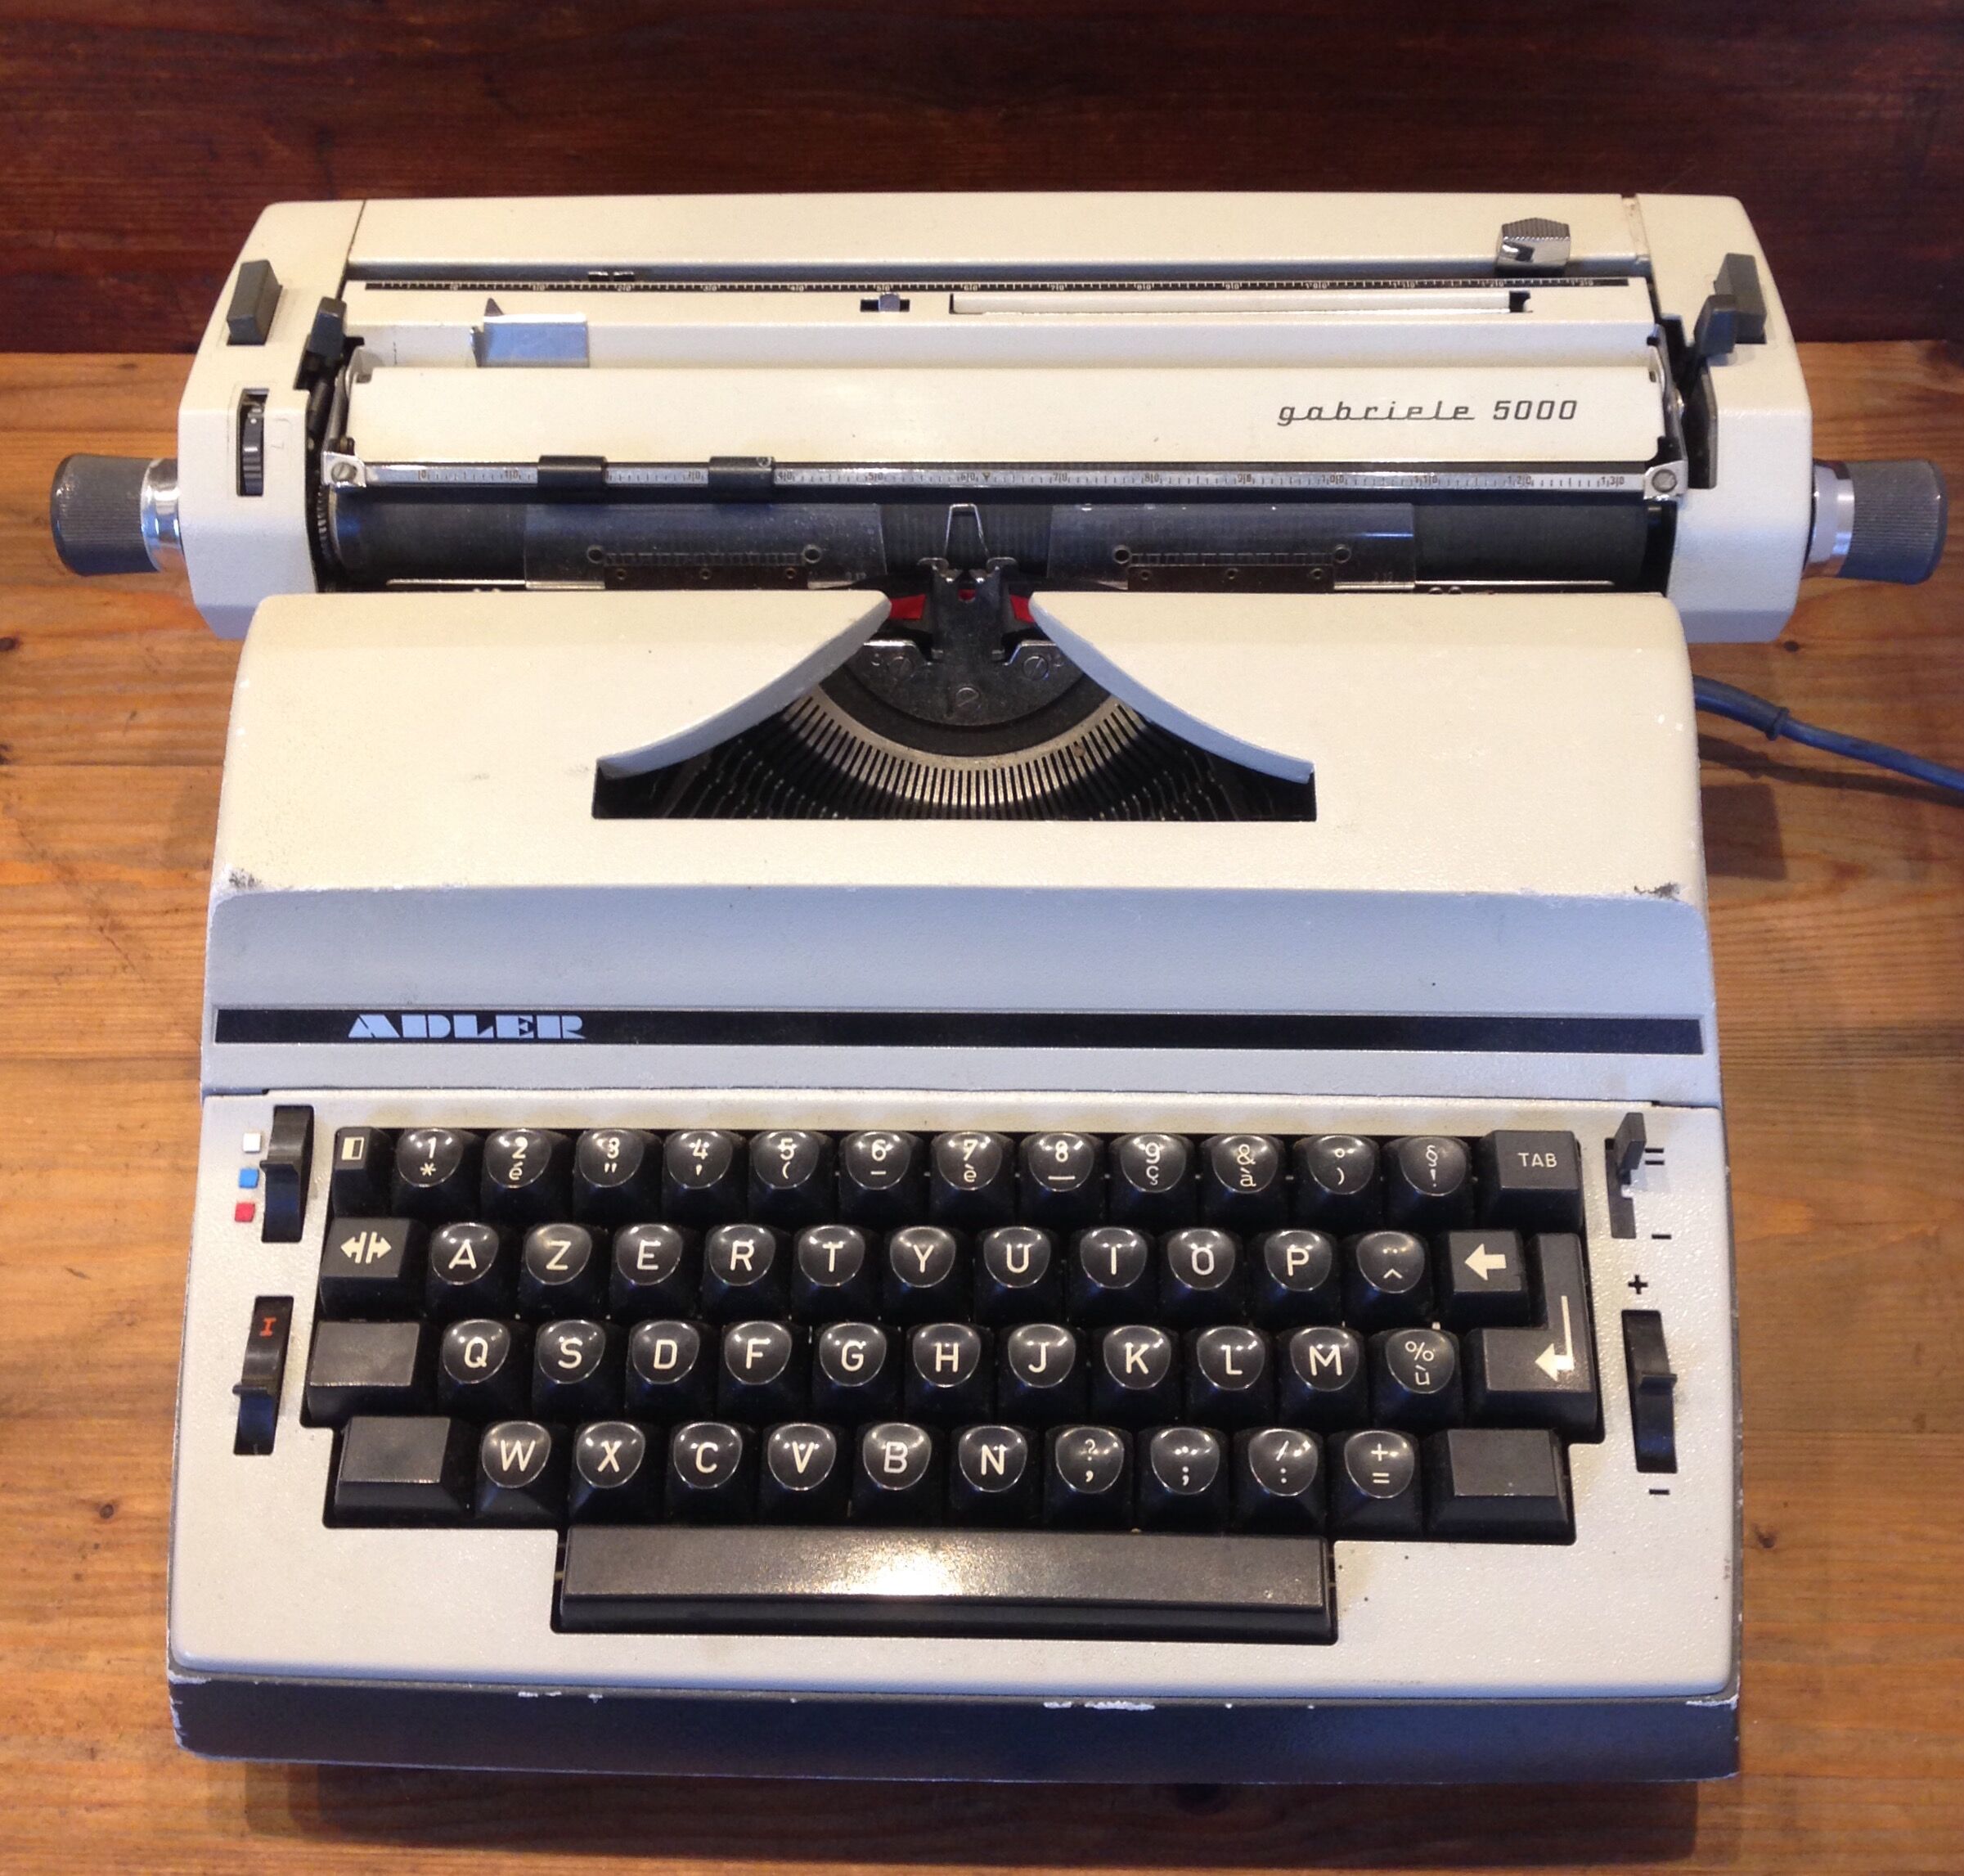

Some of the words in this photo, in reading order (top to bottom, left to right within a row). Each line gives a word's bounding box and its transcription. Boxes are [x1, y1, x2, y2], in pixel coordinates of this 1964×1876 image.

[1278, 400, 1475, 426] gabriele
[1493, 399, 1578, 421] 5000
[348, 1014, 586, 1040] ADLER
[426, 1136, 437, 1159] 1
[511, 1136, 528, 1159] 2
[606, 1136, 620, 1159] 3
[692, 1138, 708, 1160] 4
[780, 1137, 795, 1161] 5
[870, 1139, 887, 1162] 6
[963, 1139, 978, 1162] 7
[1054, 1140, 1069, 1163] 8
[1145, 1142, 1161, 1164] 9
[1236, 1143, 1256, 1165] &
[1518, 1152, 1557, 1168] TAB
[508, 1161, 524, 1181] é
[782, 1162, 791, 1179] (
[964, 1163, 978, 1183] è
[1146, 1165, 1160, 1185] ç
[1239, 1167, 1256, 1187] à
[1336, 1167, 1346, 1185] )
[1431, 1168, 1437, 1188] !
[447, 1239, 477, 1270] A
[544, 1239, 570, 1271] Z
[636, 1239, 660, 1271] E
[730, 1239, 754, 1271] R
[822, 1242, 843, 1273] T
[912, 1243, 935, 1273] Y
[1005, 1244, 1031, 1273] U
[1108, 1244, 1119, 1275] I
[1189, 1245, 1215, 1275] O
[1286, 1246, 1310, 1276] P
[462, 1336, 488, 1369] Q
[557, 1337, 582, 1369] S
[653, 1339, 678, 1370] D
[744, 1338, 771, 1370] F
[839, 1340, 865, 1371] G
[933, 1342, 960, 1373] H
[1026, 1342, 1048, 1373] J
[1123, 1343, 1150, 1374] K
[1223, 1344, 1244, 1375] L
[1309, 1344, 1343, 1376] M
[1404, 1341, 1434, 1361] %
[1415, 1365, 1430, 1384] ù
[498, 1439, 537, 1472] W
[597, 1440, 621, 1473] X
[694, 1442, 719, 1473] C
[791, 1441, 815, 1473] V
[883, 1440, 907, 1473] B
[980, 1444, 1005, 1475] N
[1085, 1438, 1096, 1461] ?
[1181, 1465, 1189, 1487] ;
